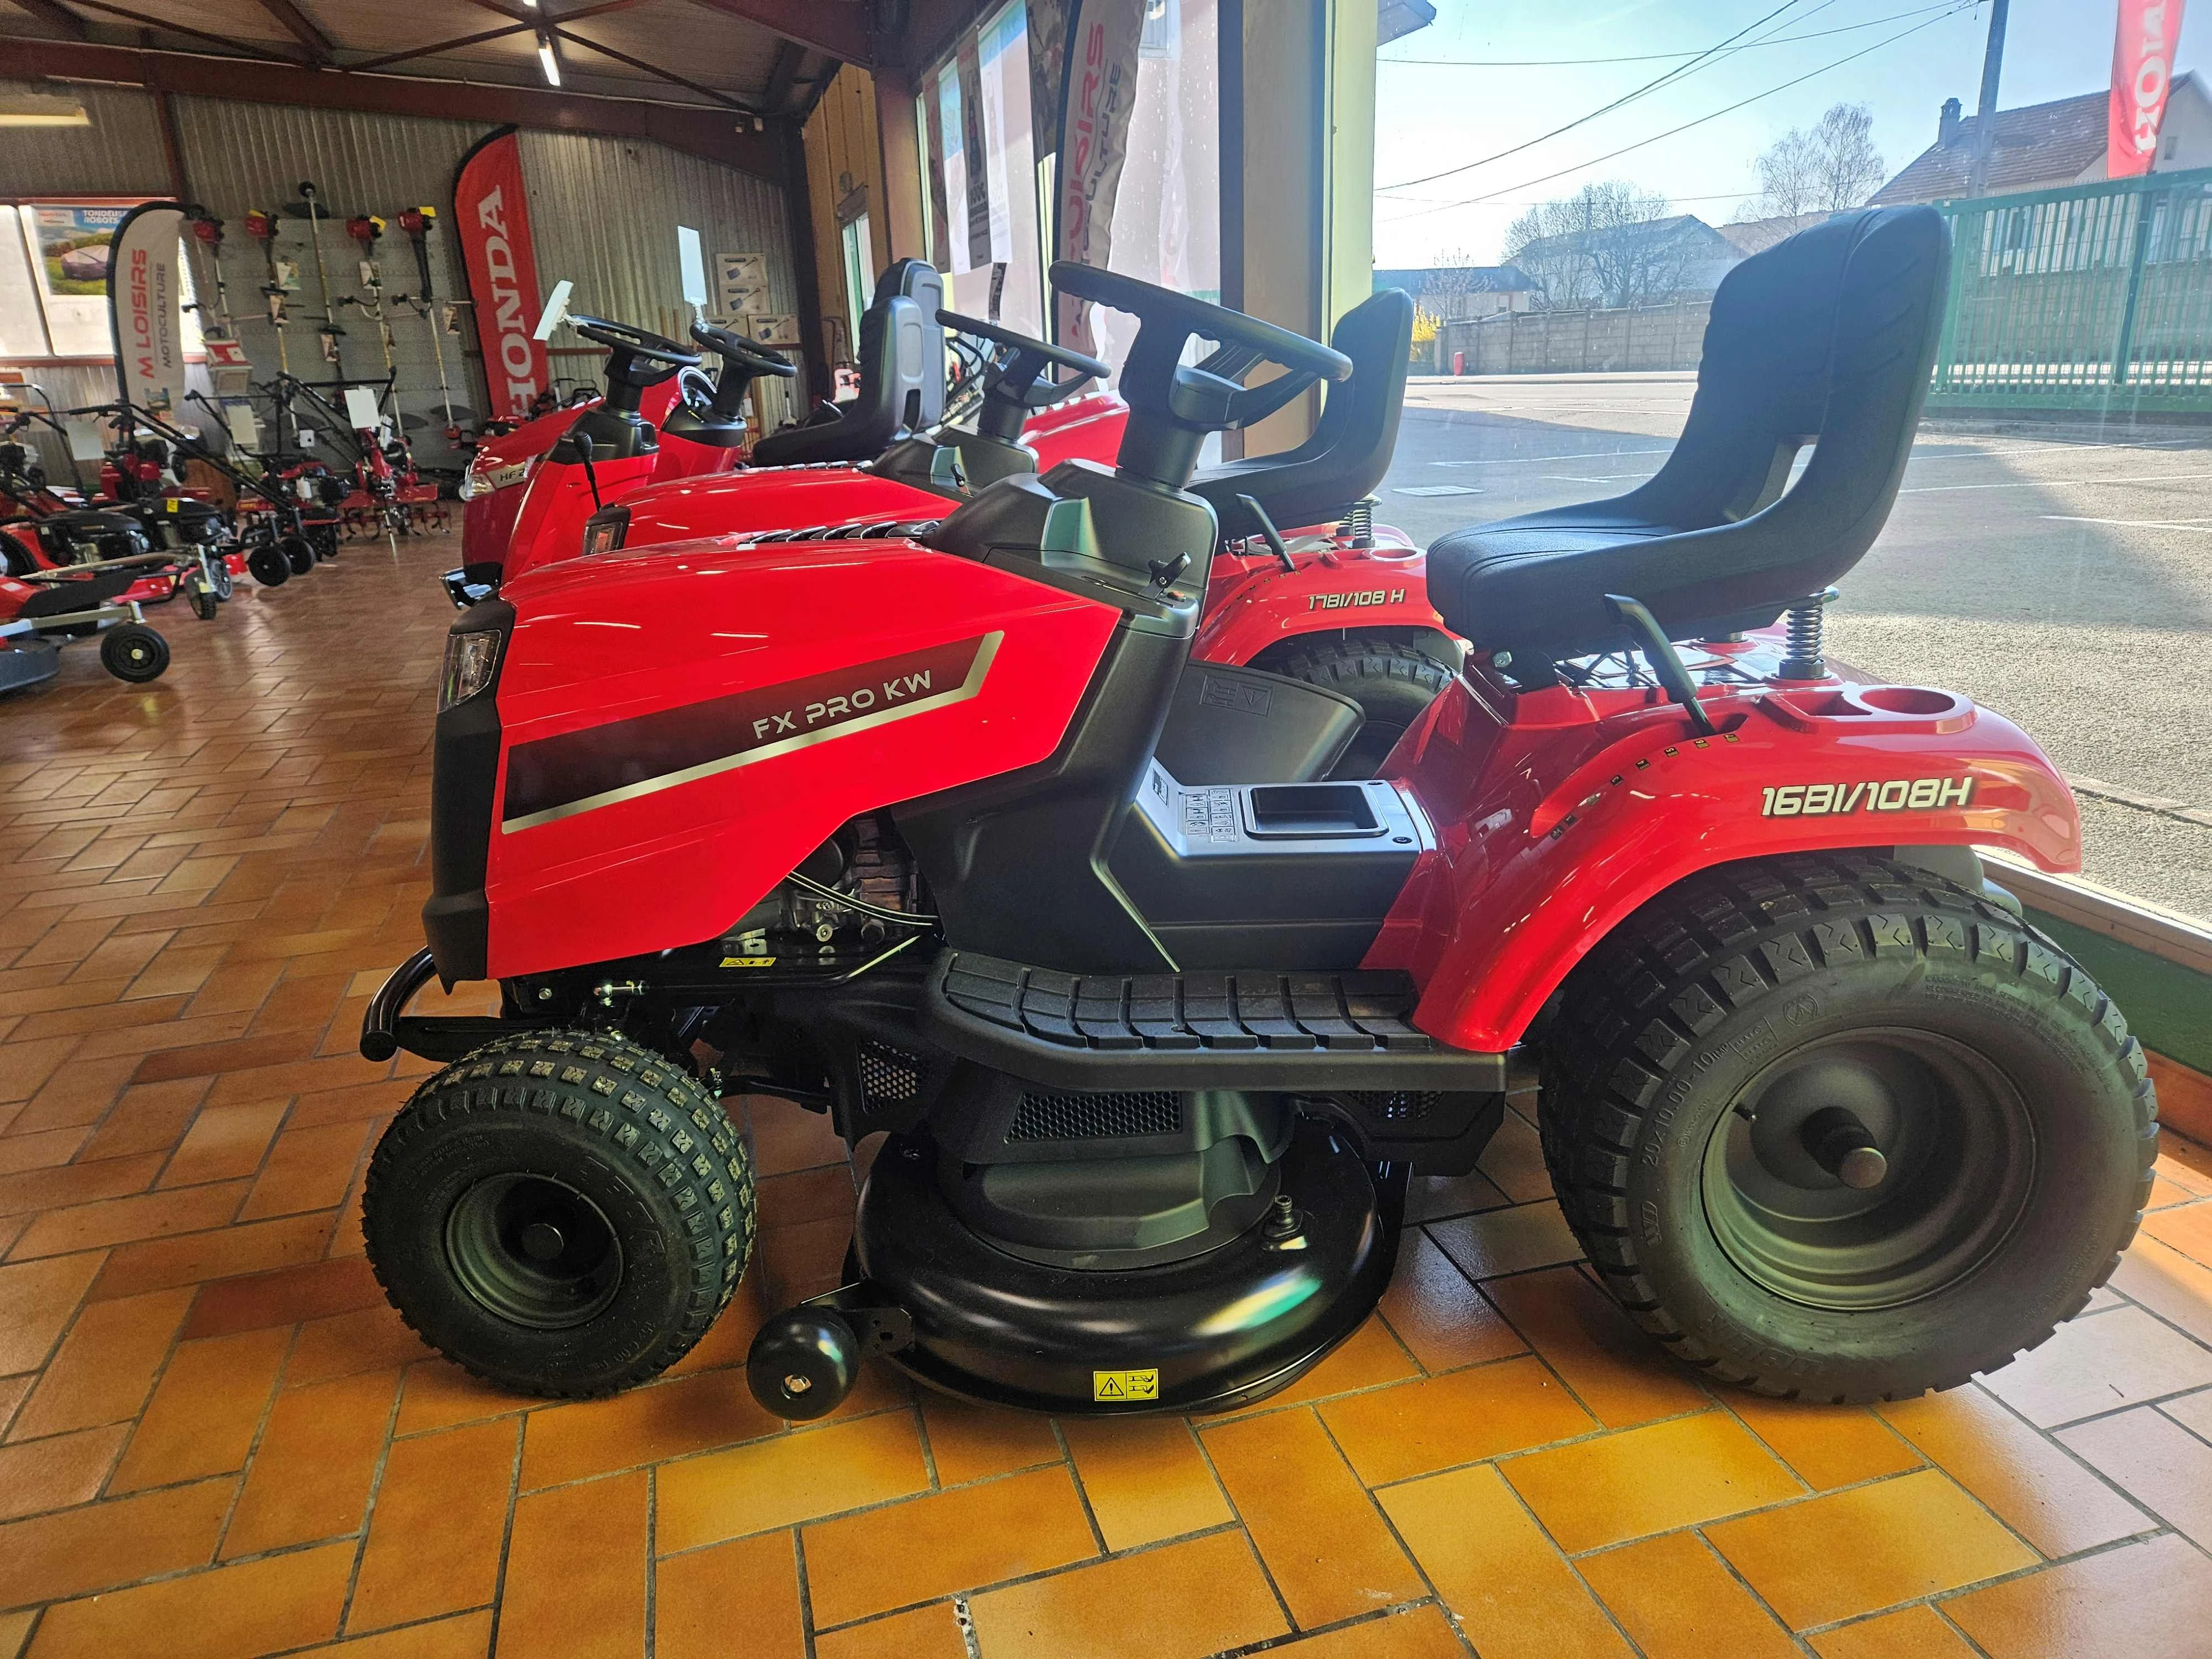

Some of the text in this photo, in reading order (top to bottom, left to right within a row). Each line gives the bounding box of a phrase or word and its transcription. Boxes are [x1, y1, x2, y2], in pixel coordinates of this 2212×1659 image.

[131, 248, 155, 379] M LOISIRS
[156, 262, 171, 369] MOTOCULTURE
[478, 185, 538, 418] HONDA
[500, 471, 515, 481] HF
[1390, 588, 1405, 603] H
[752, 670, 931, 739] FX PRO KW
